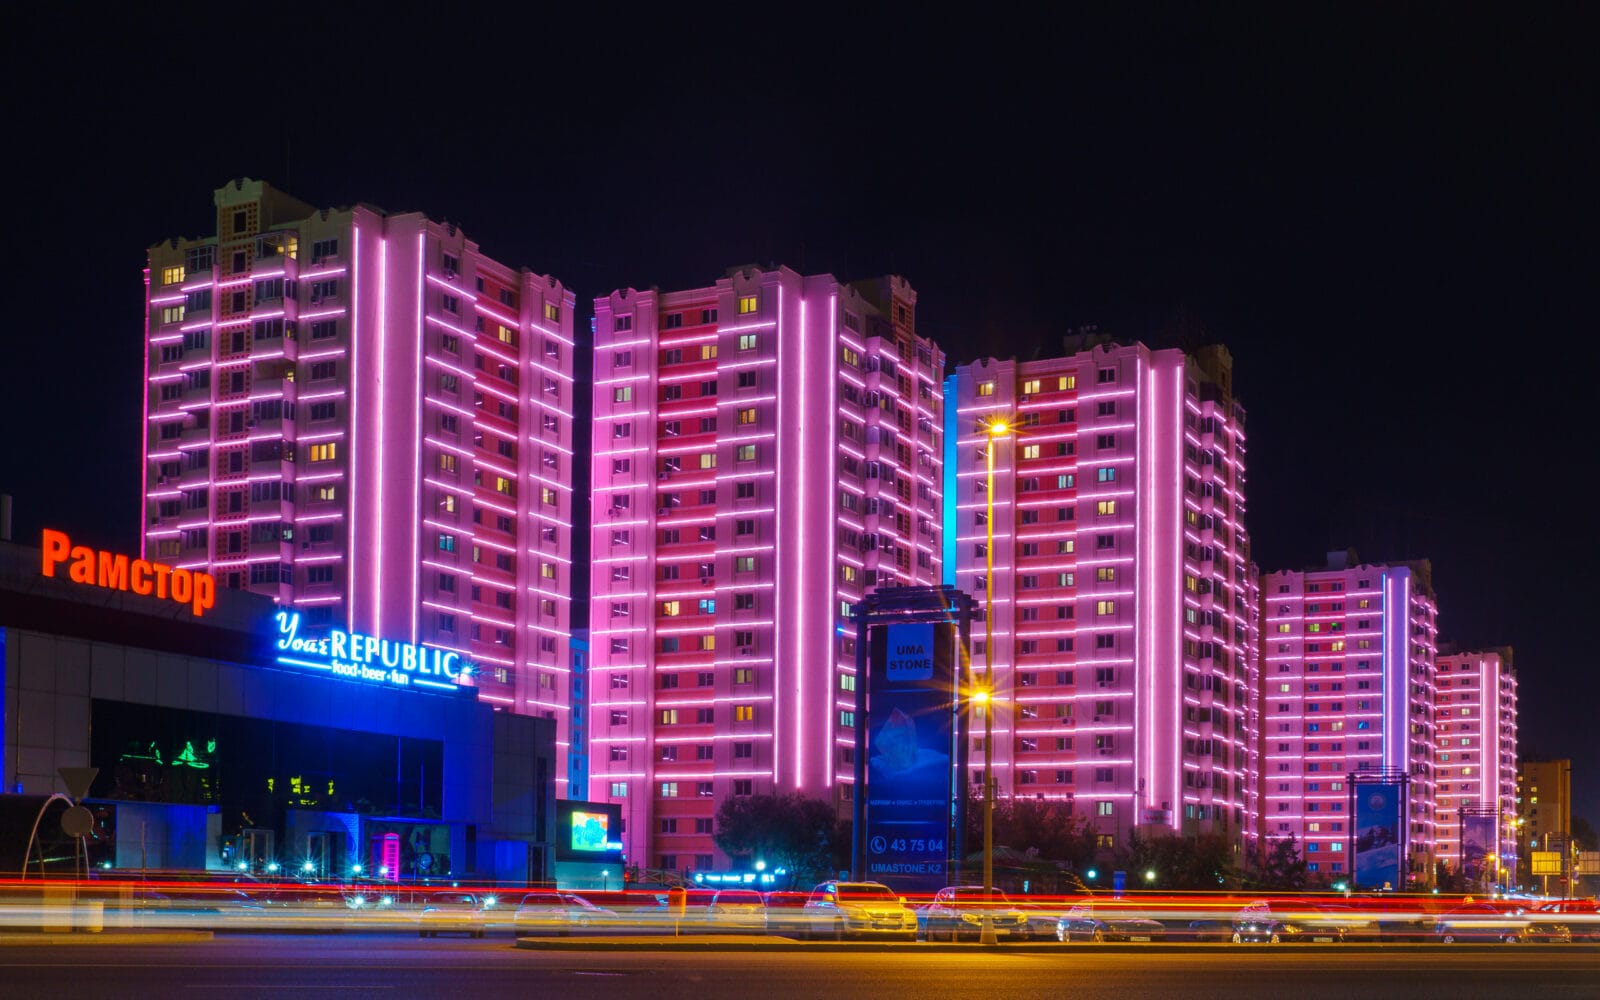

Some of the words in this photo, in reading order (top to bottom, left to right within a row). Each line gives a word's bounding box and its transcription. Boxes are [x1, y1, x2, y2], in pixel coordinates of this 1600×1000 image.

[42, 528, 216, 617] Рамстор
[331, 630, 460, 679] REPUBLIC
[896, 644, 925, 656] UMA
[889, 659, 931, 671] STONE
[890, 839, 906, 852] 43
[910, 839, 925, 852] 75
[928, 839, 944, 852] 04
